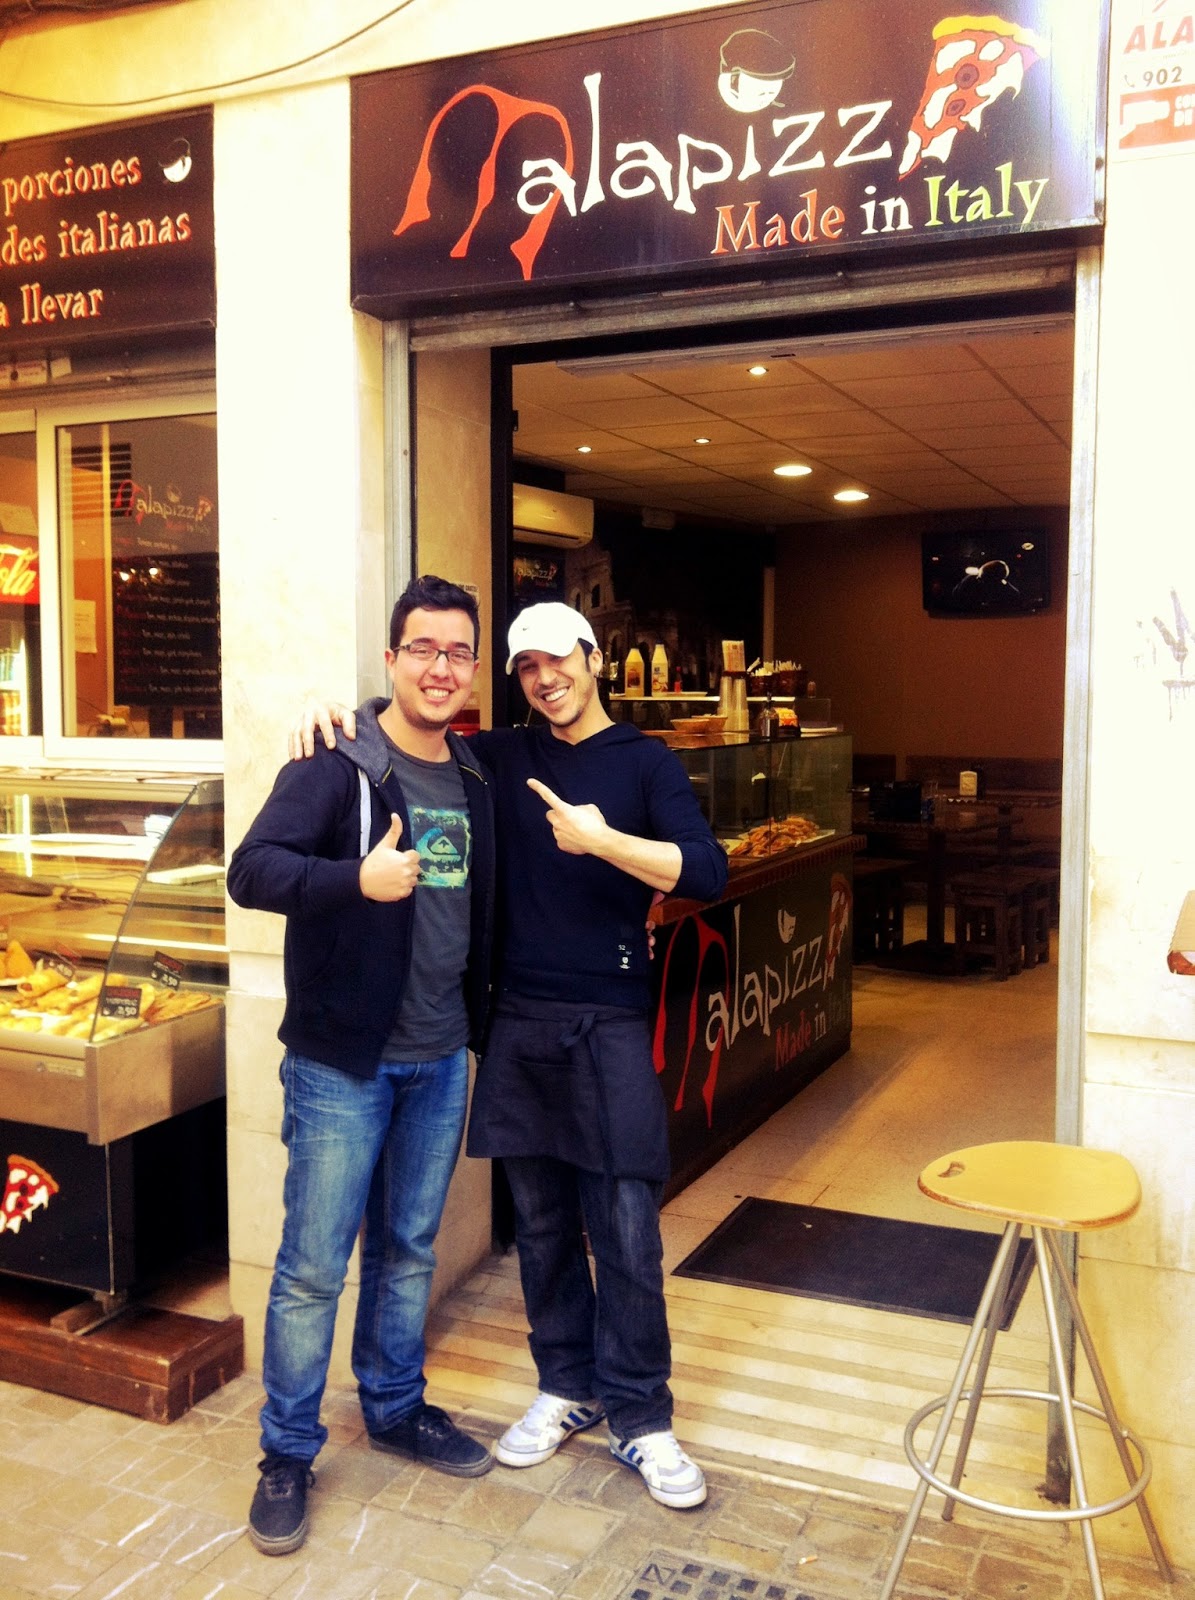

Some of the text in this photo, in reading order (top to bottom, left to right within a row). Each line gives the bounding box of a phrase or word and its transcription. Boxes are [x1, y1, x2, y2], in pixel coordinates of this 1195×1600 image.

[1143, 66, 1183, 87] 902
[2, 156, 142, 217] porciones
[711, 161, 1049, 256] Made in Italy
[0, 210, 192, 266] des italianas
[20, 282, 104, 325] llevar
[775, 1009, 812, 1071] Made
[814, 1002, 827, 1041] in
